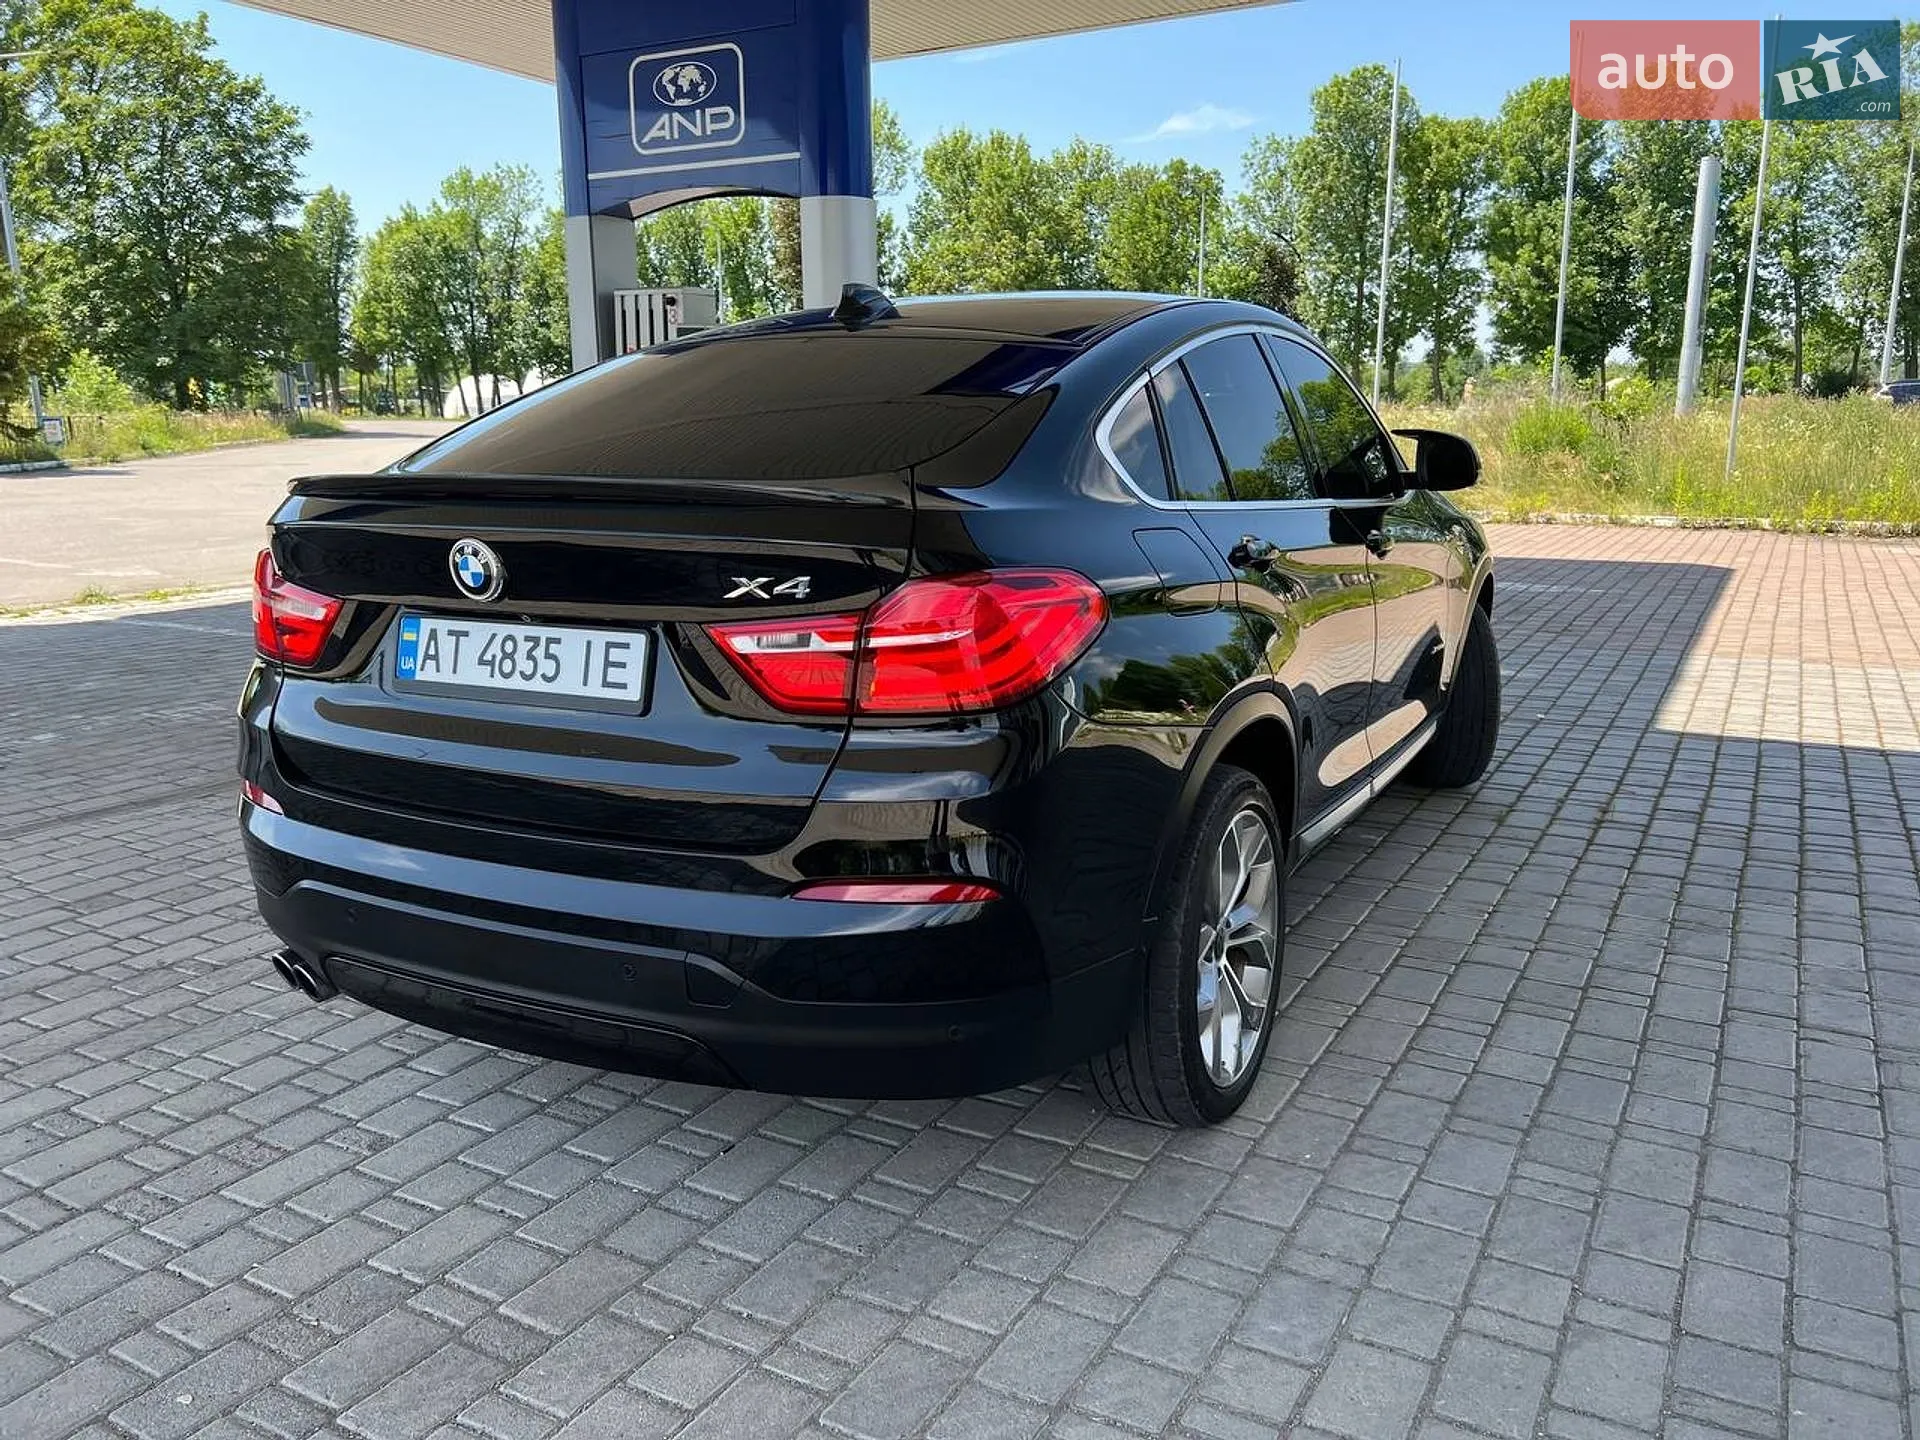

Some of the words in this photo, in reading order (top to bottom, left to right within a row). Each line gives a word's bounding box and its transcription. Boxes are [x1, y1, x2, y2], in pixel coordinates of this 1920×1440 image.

[641, 105, 735, 144] ANP
[723, 576, 811, 599] X4
[400, 655, 416, 670] UA
[420, 627, 470, 675] AT
[477, 632, 562, 684] 4835
[582, 639, 631, 690] IE
